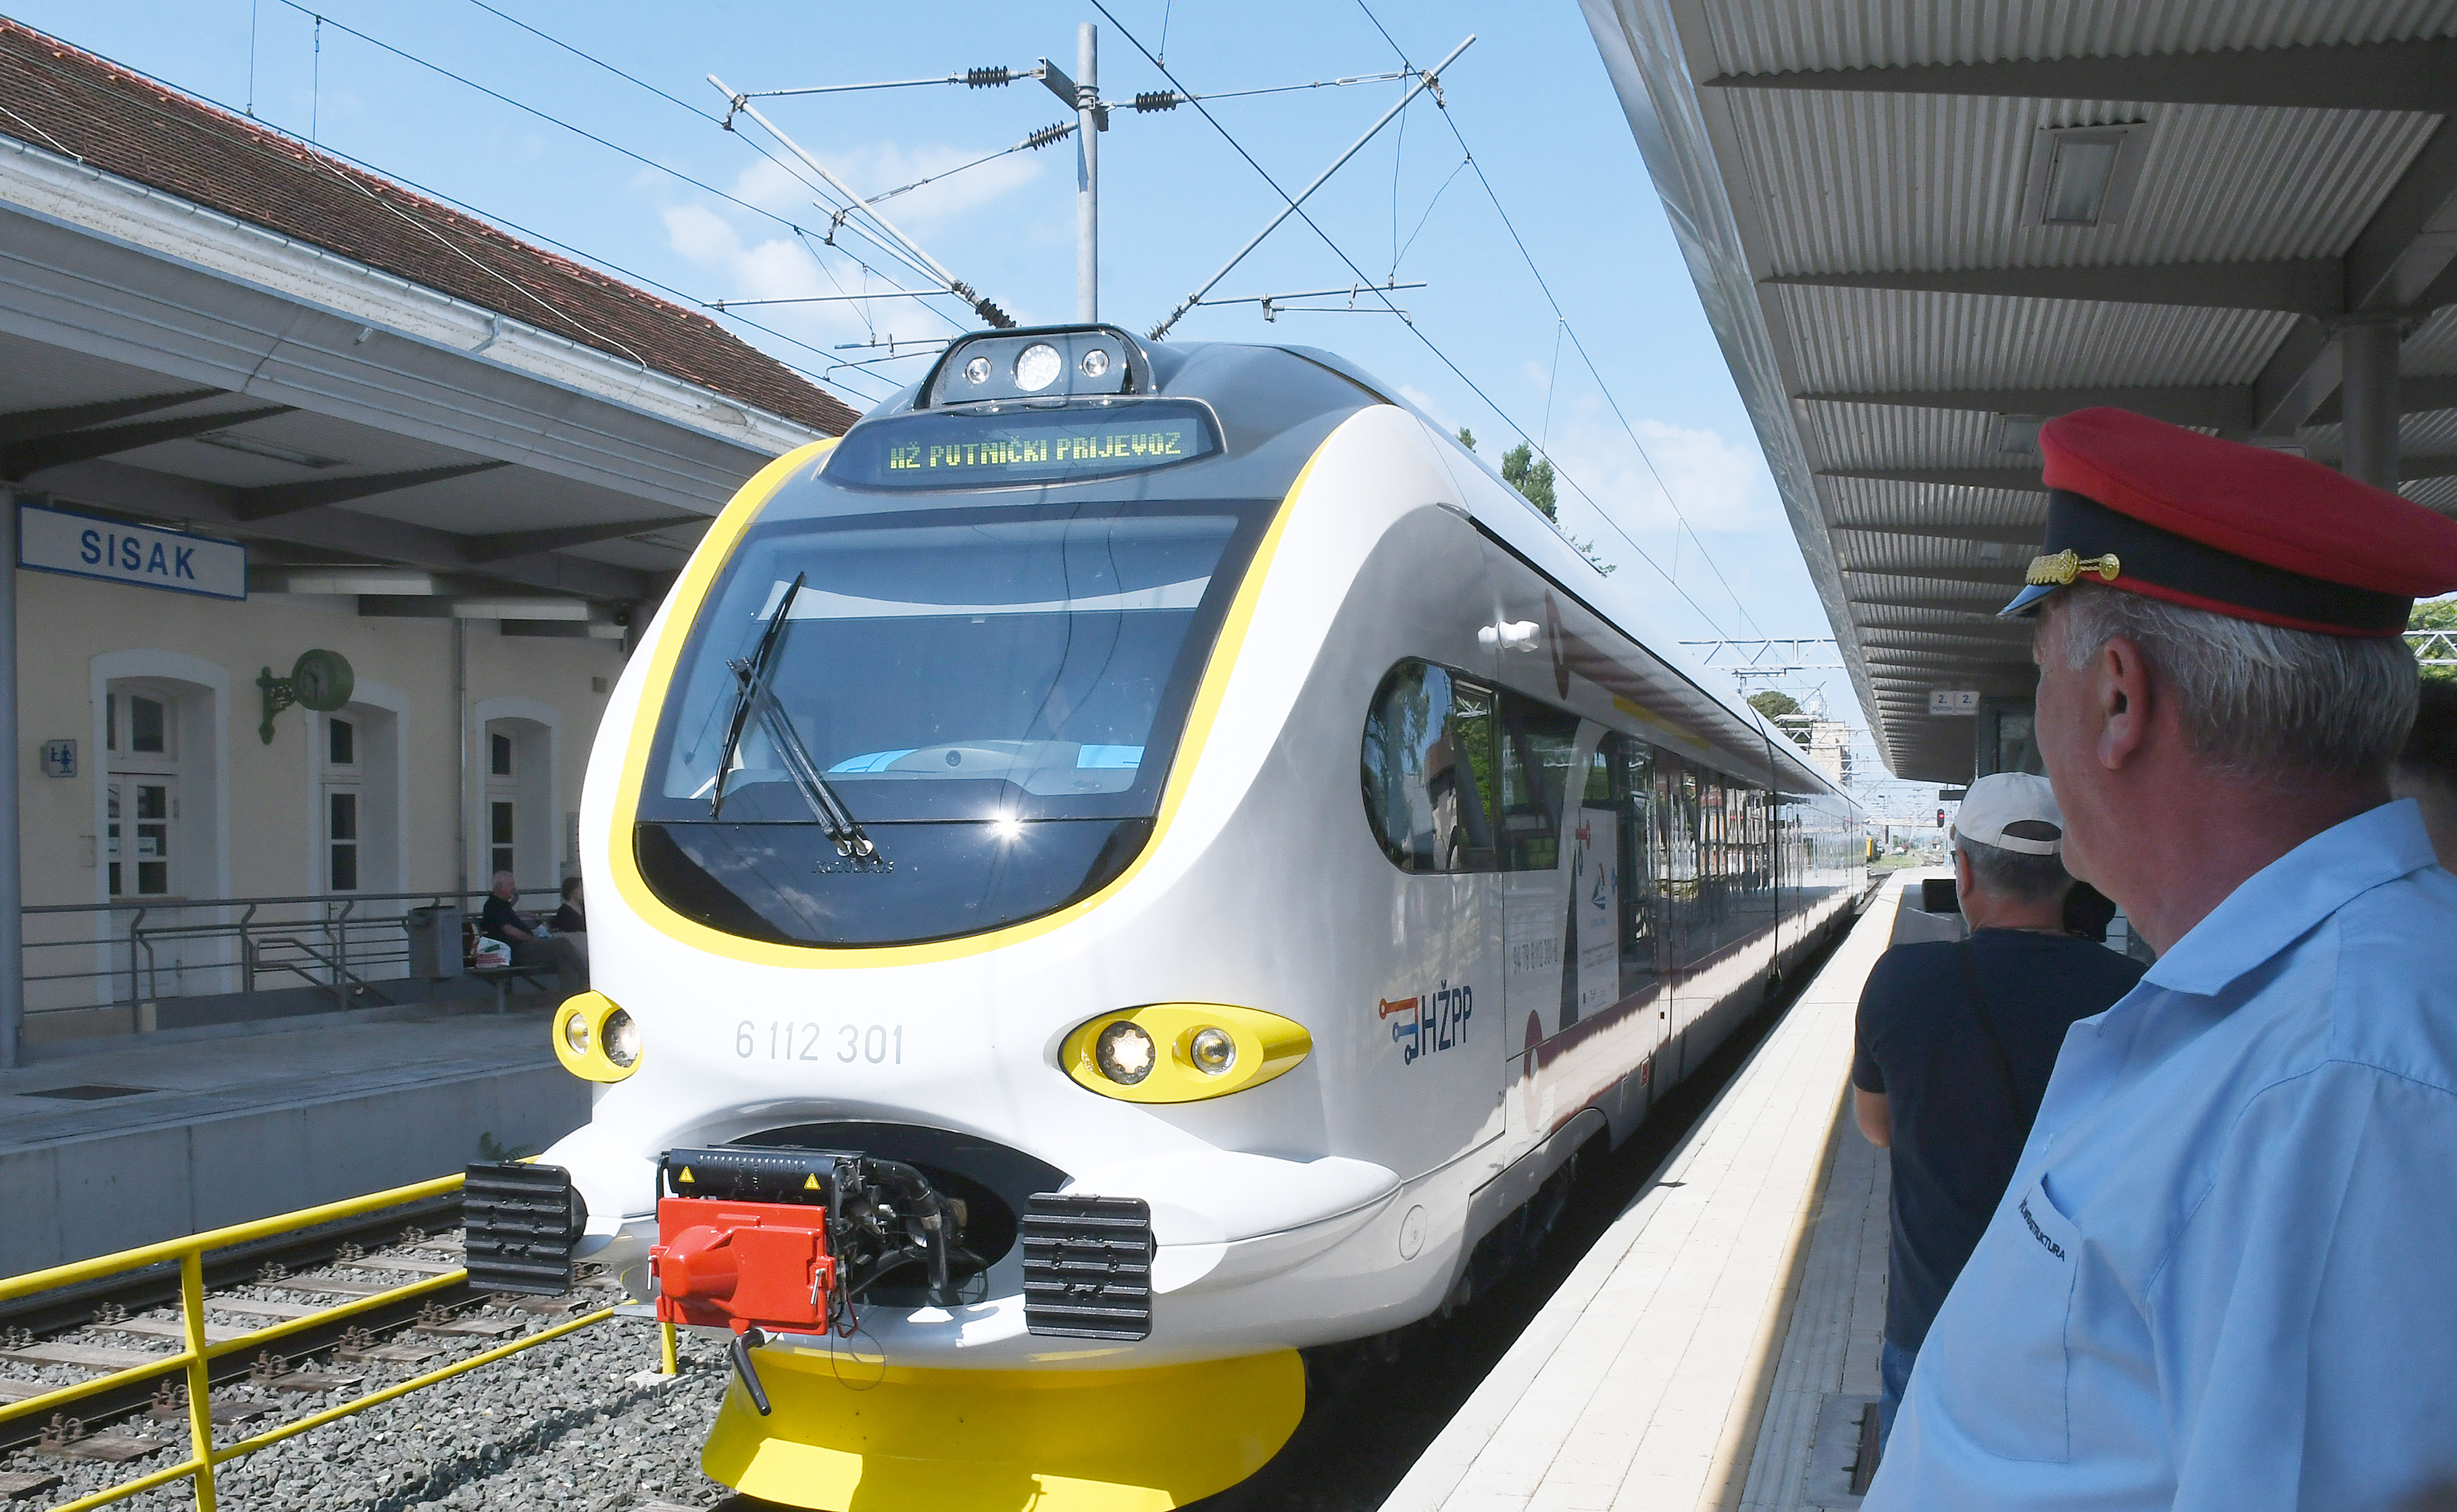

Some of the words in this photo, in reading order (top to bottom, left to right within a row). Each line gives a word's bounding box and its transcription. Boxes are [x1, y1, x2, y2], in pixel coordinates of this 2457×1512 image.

[889, 440, 921, 469] HŽ
[929, 435, 1048, 467] PUTNIČKI
[1056, 432, 1182, 460] PRIJEVOZ
[80, 529, 195, 580] SISAK
[736, 1019, 755, 1058] 6
[770, 1021, 820, 1061] 112
[837, 1024, 903, 1064] 301
[1421, 980, 1472, 1056] HŽPP
